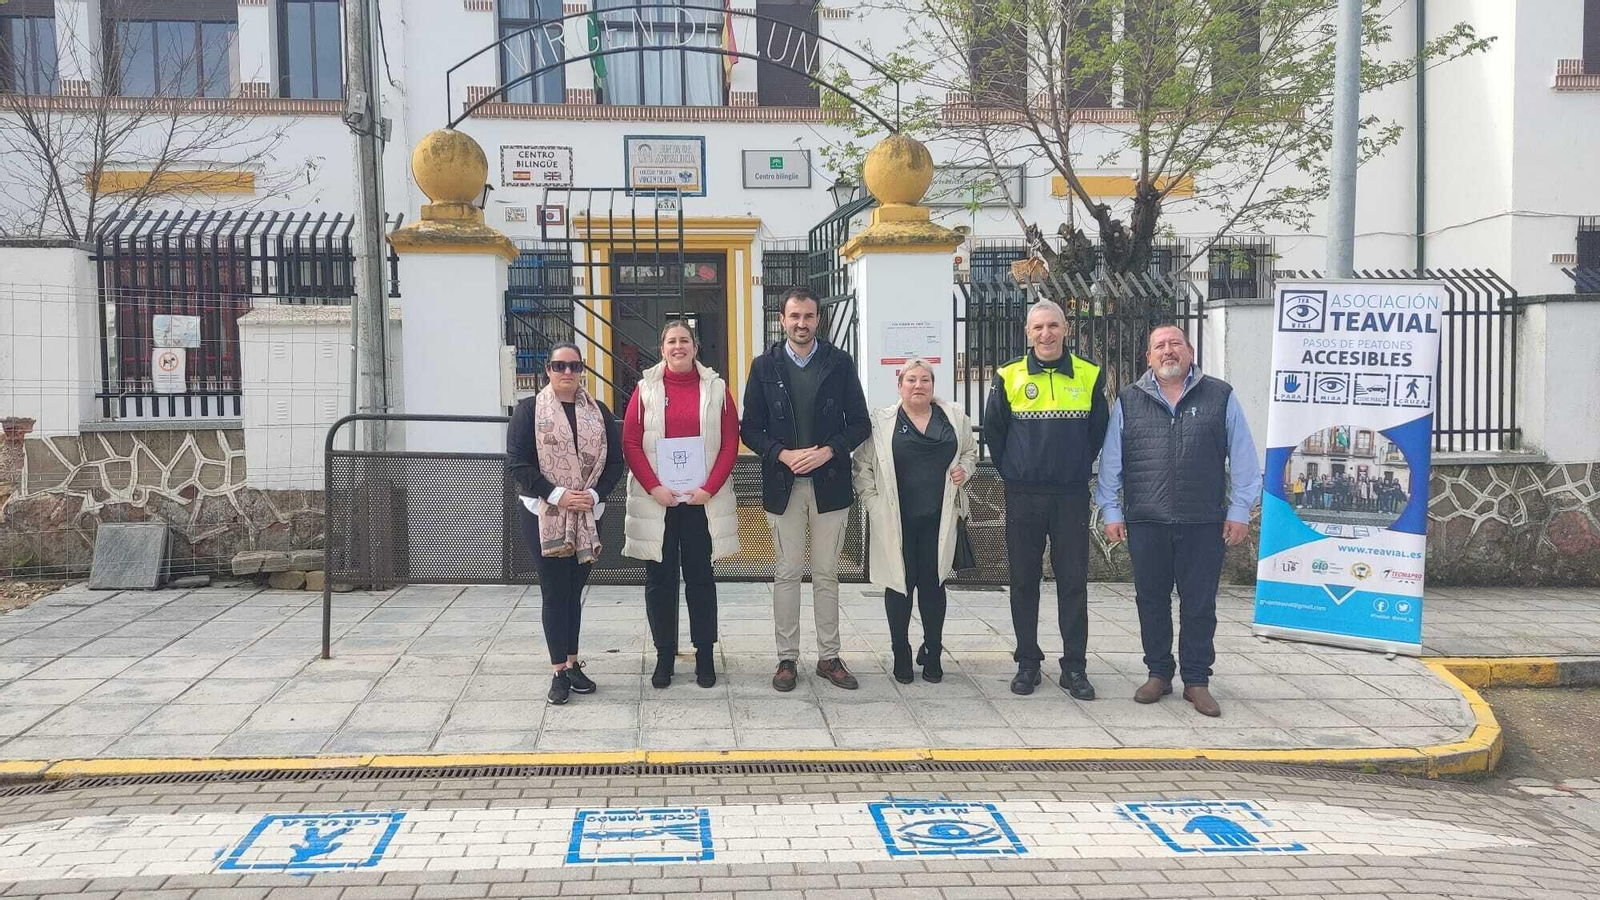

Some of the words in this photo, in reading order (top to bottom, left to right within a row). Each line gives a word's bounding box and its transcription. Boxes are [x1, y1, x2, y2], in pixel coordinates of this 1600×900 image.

[502, 7, 655, 74] VIRGEN
[674, 7, 723, 49] DE
[518, 151, 555, 159] CENTRO
[516, 159, 559, 169] BILINGÜE
[754, 172, 775, 180] Centro
[775, 172, 799, 181] bilingüe
[1330, 293, 1439, 310] ASOCIACIÓN
[1330, 311, 1438, 334] TEAVIAL
[1303, 338, 1337, 348] PASOS
[1340, 339, 1354, 349] DE
[1357, 340, 1413, 350] PEATONES
[1301, 350, 1413, 367] ACCESIBLES
[281, 819, 380, 827] CRUZA
[587, 815, 644, 823] PARADO
